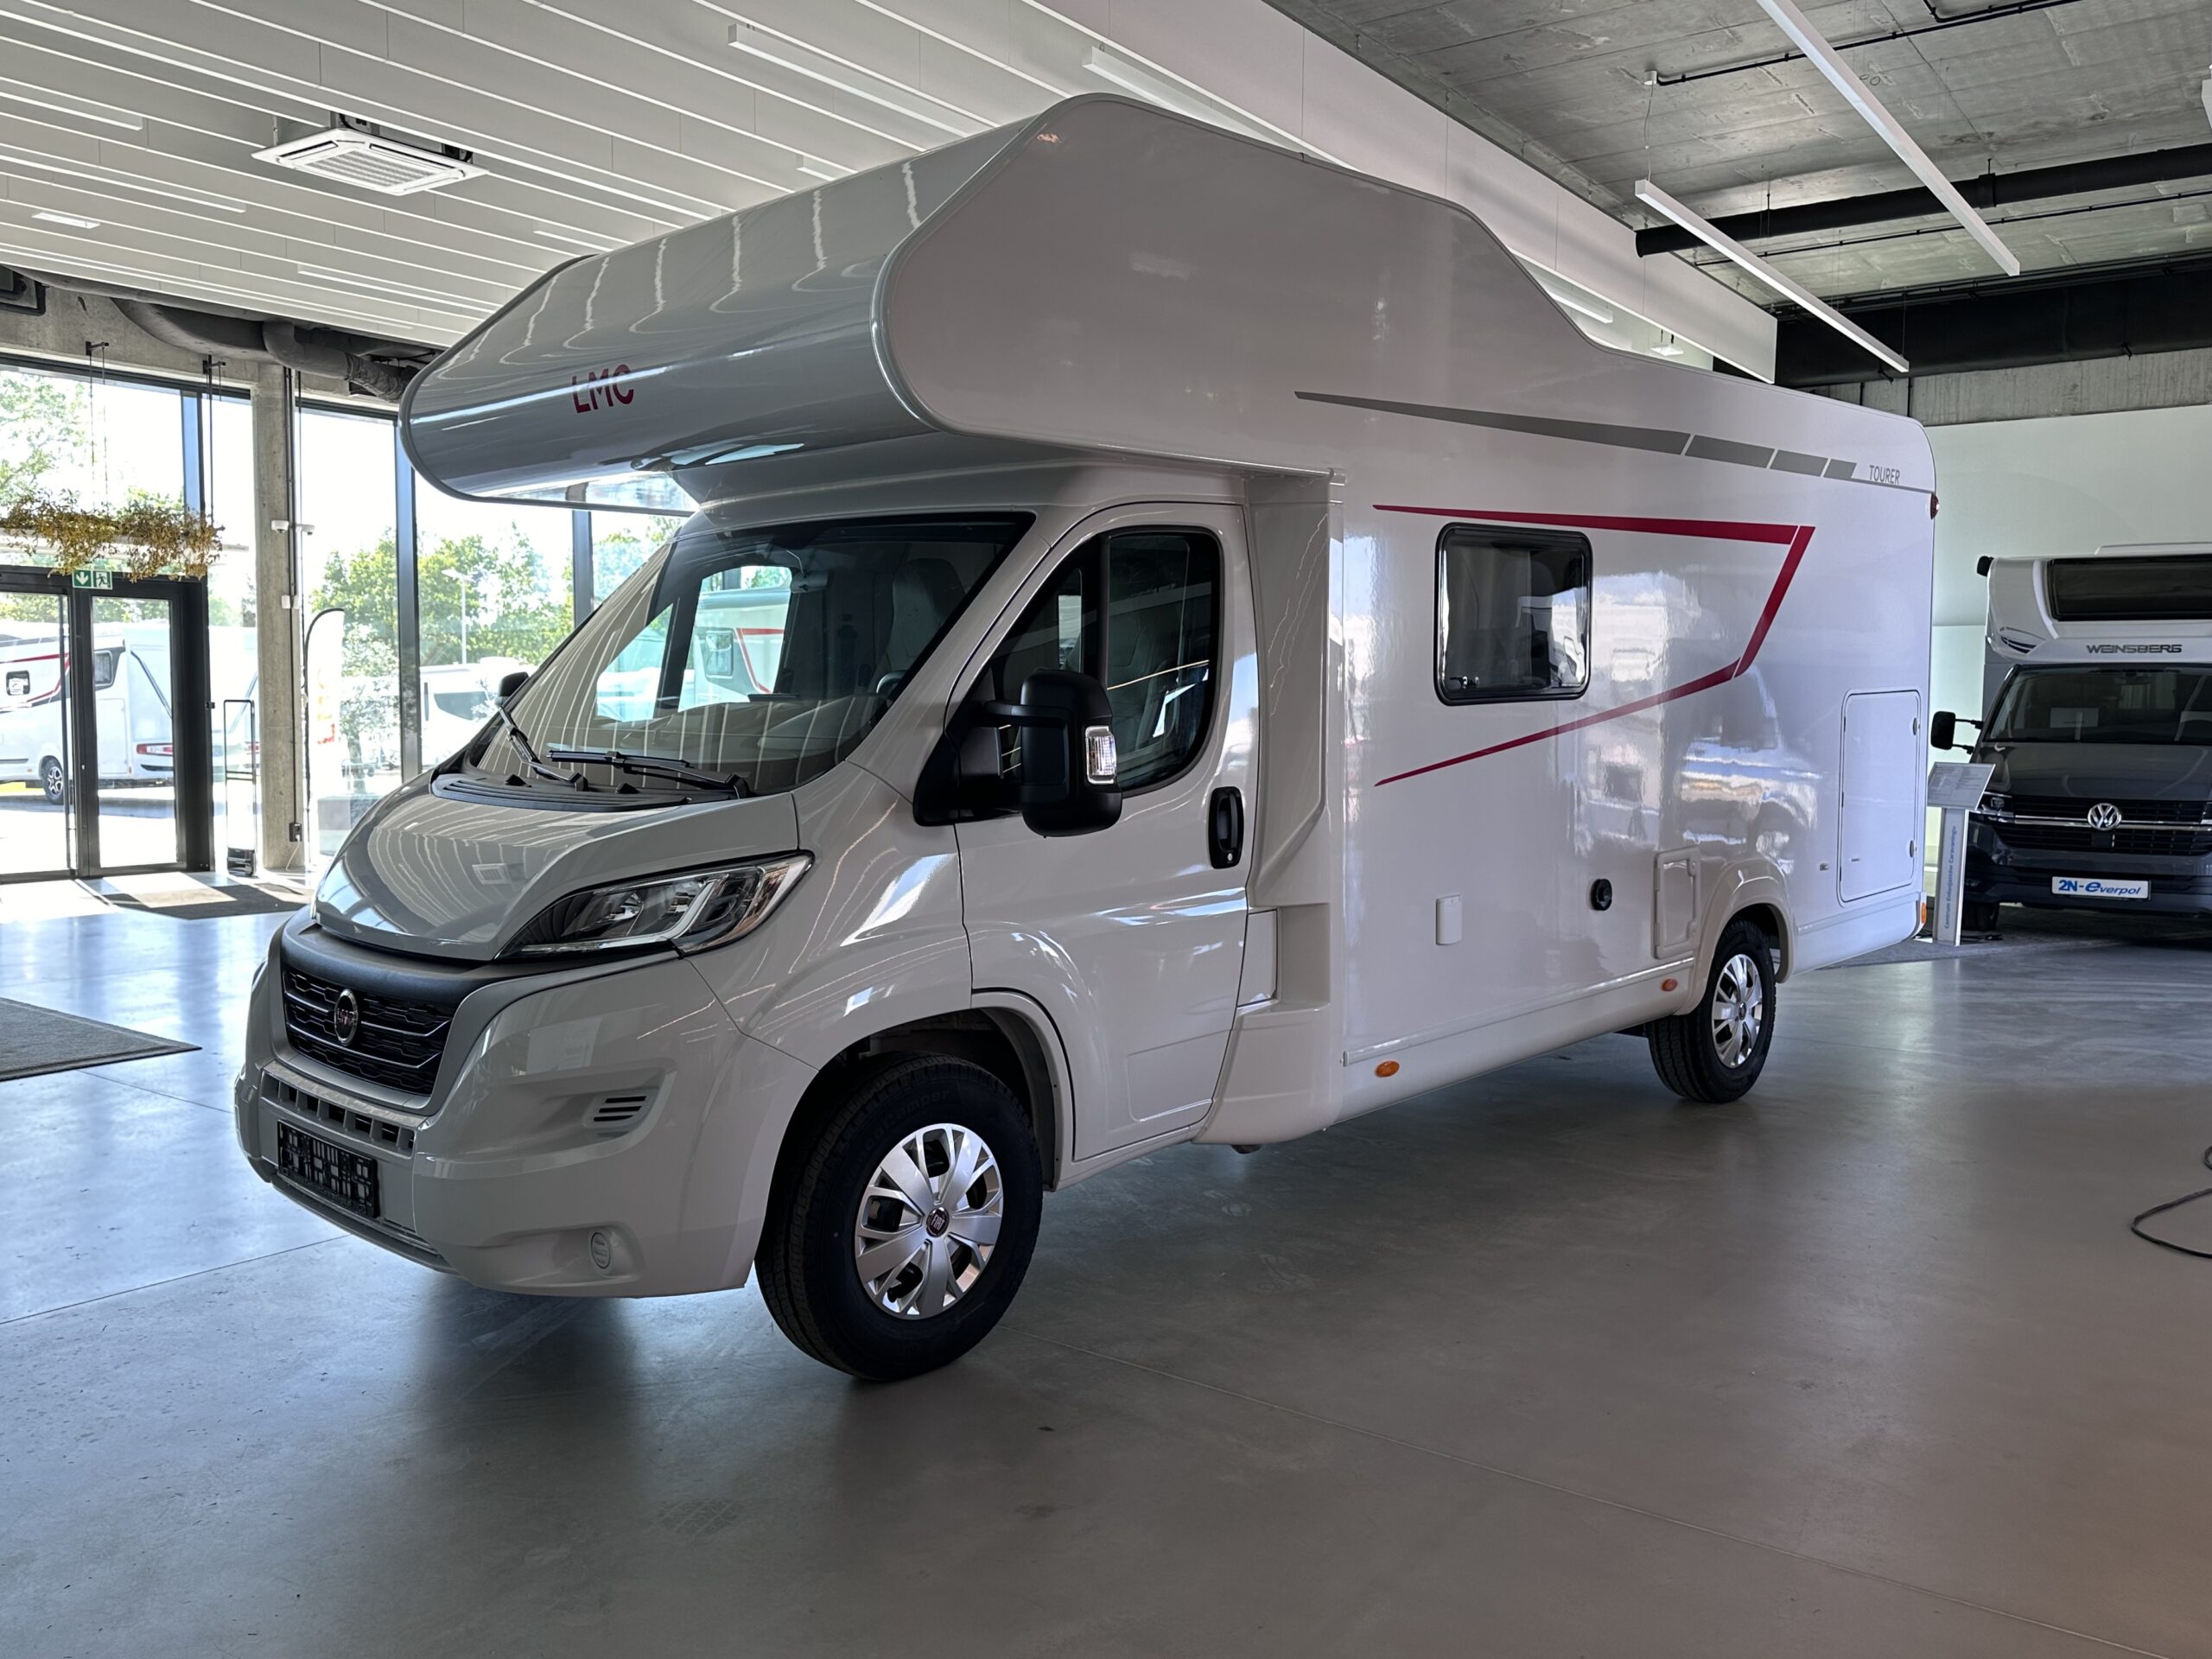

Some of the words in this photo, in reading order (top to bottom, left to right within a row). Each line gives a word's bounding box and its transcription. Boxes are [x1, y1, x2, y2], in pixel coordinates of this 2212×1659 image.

[572, 365, 634, 413] LMC
[1869, 465, 1900, 486] TOURER
[2087, 645, 2182, 654] WEINSBERG
[931, 1214, 945, 1230] FIAT
